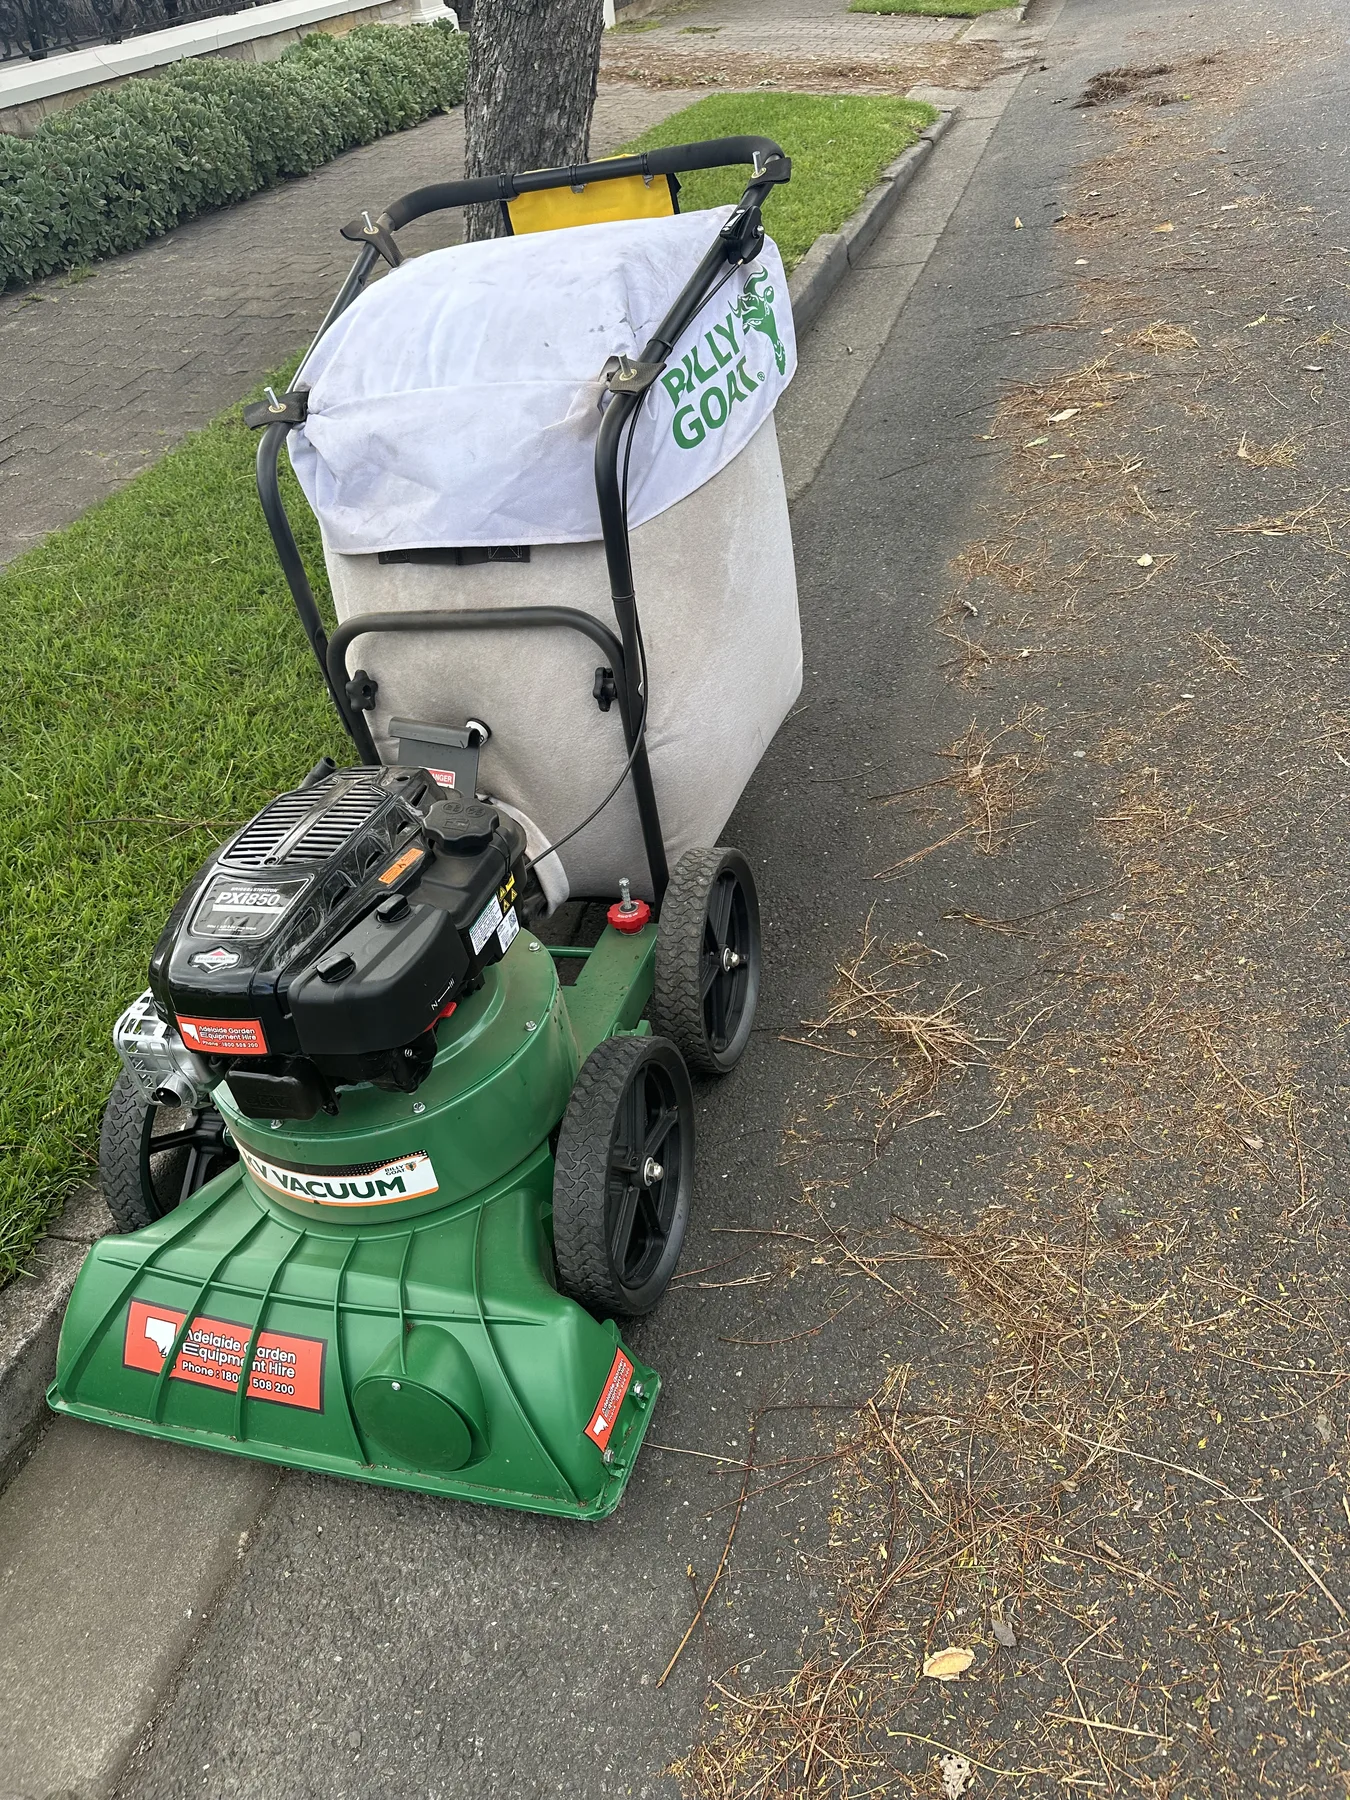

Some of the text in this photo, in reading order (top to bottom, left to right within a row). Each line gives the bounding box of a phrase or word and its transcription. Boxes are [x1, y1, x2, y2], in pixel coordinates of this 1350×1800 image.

[660, 312, 740, 409] BILLY
[672, 355, 759, 450] GOAT
[431, 773, 453, 783] ANGER
[198, 1026, 228, 1034] Adelaide
[199, 1031, 241, 1041] Equipment
[384, 1164, 404, 1172] BILLY
[271, 1169, 407, 1200] VACUUM
[185, 1329, 241, 1352] Adelaide
[182, 1360, 214, 1377] Phone
[221, 1370, 242, 1382] 180
[252, 1378, 272, 1391] 508
[274, 1382, 295, 1395] 200
[268, 1361, 296, 1378] Hire
